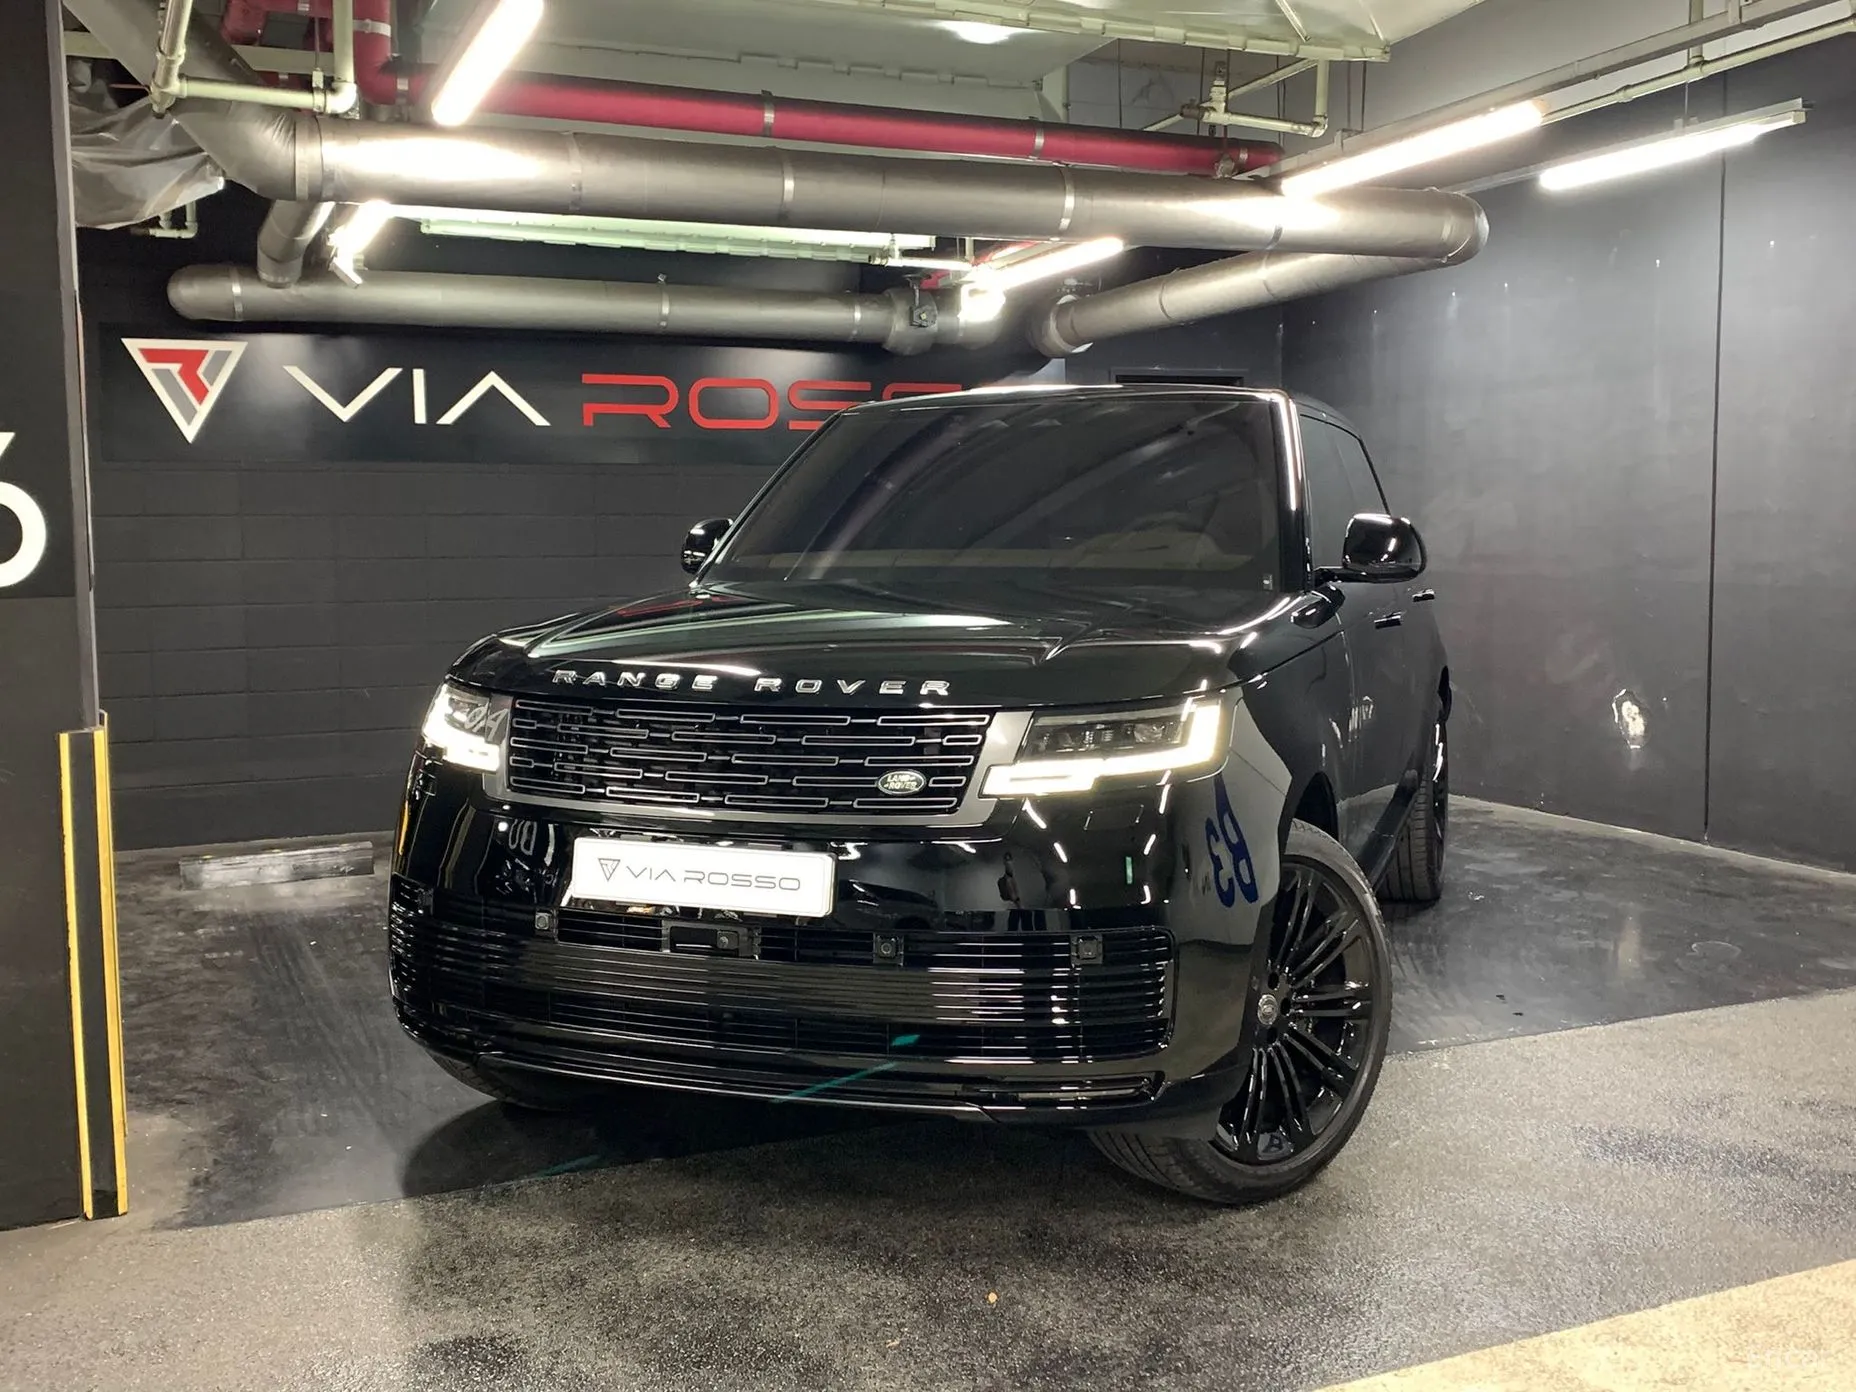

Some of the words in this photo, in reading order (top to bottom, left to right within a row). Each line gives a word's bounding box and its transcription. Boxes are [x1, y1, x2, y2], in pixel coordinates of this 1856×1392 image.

[283, 365, 551, 426] VIA
[552, 669, 718, 692] RANGE
[754, 677, 951, 697] ROVER
[626, 865, 676, 882] VIA
[684, 869, 800, 891] ROSSO
